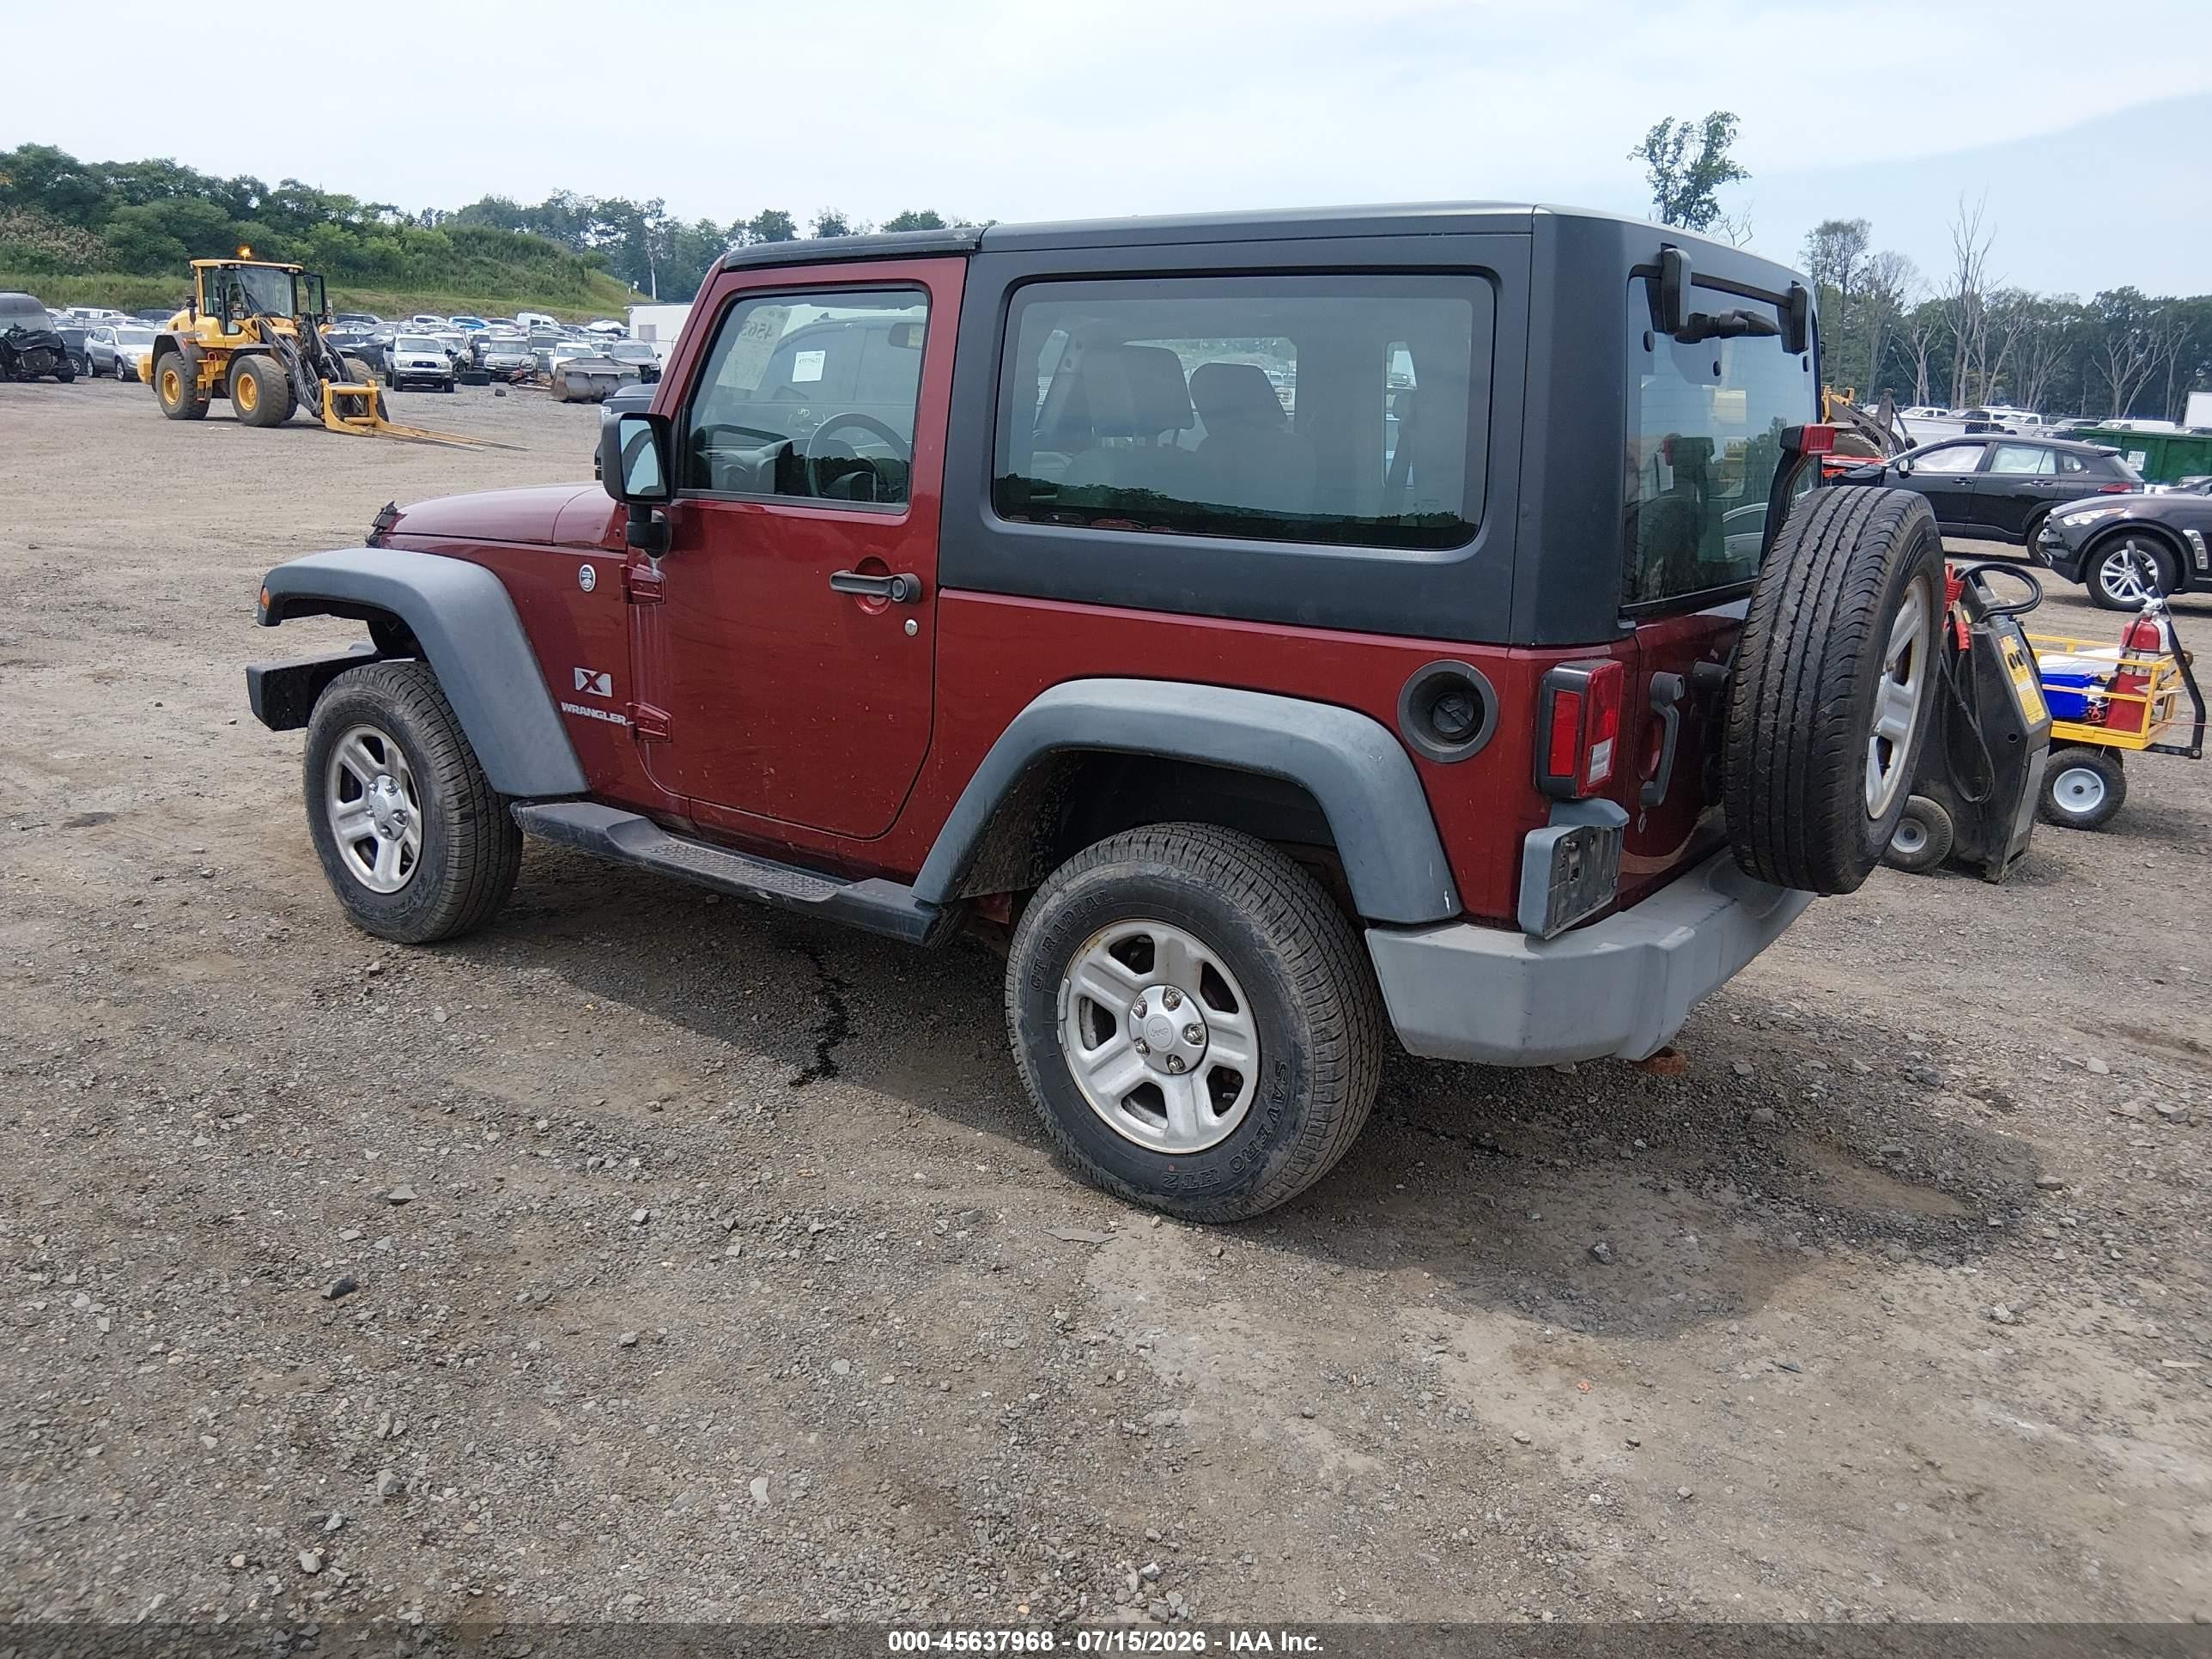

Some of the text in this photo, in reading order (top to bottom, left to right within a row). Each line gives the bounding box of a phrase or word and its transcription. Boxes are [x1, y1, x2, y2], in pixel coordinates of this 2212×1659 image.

[561, 701, 627, 726] WRANGLER
[1030, 890, 1114, 991] GT RADIAL
[1162, 1058, 1289, 1190] SAVERO HT2
